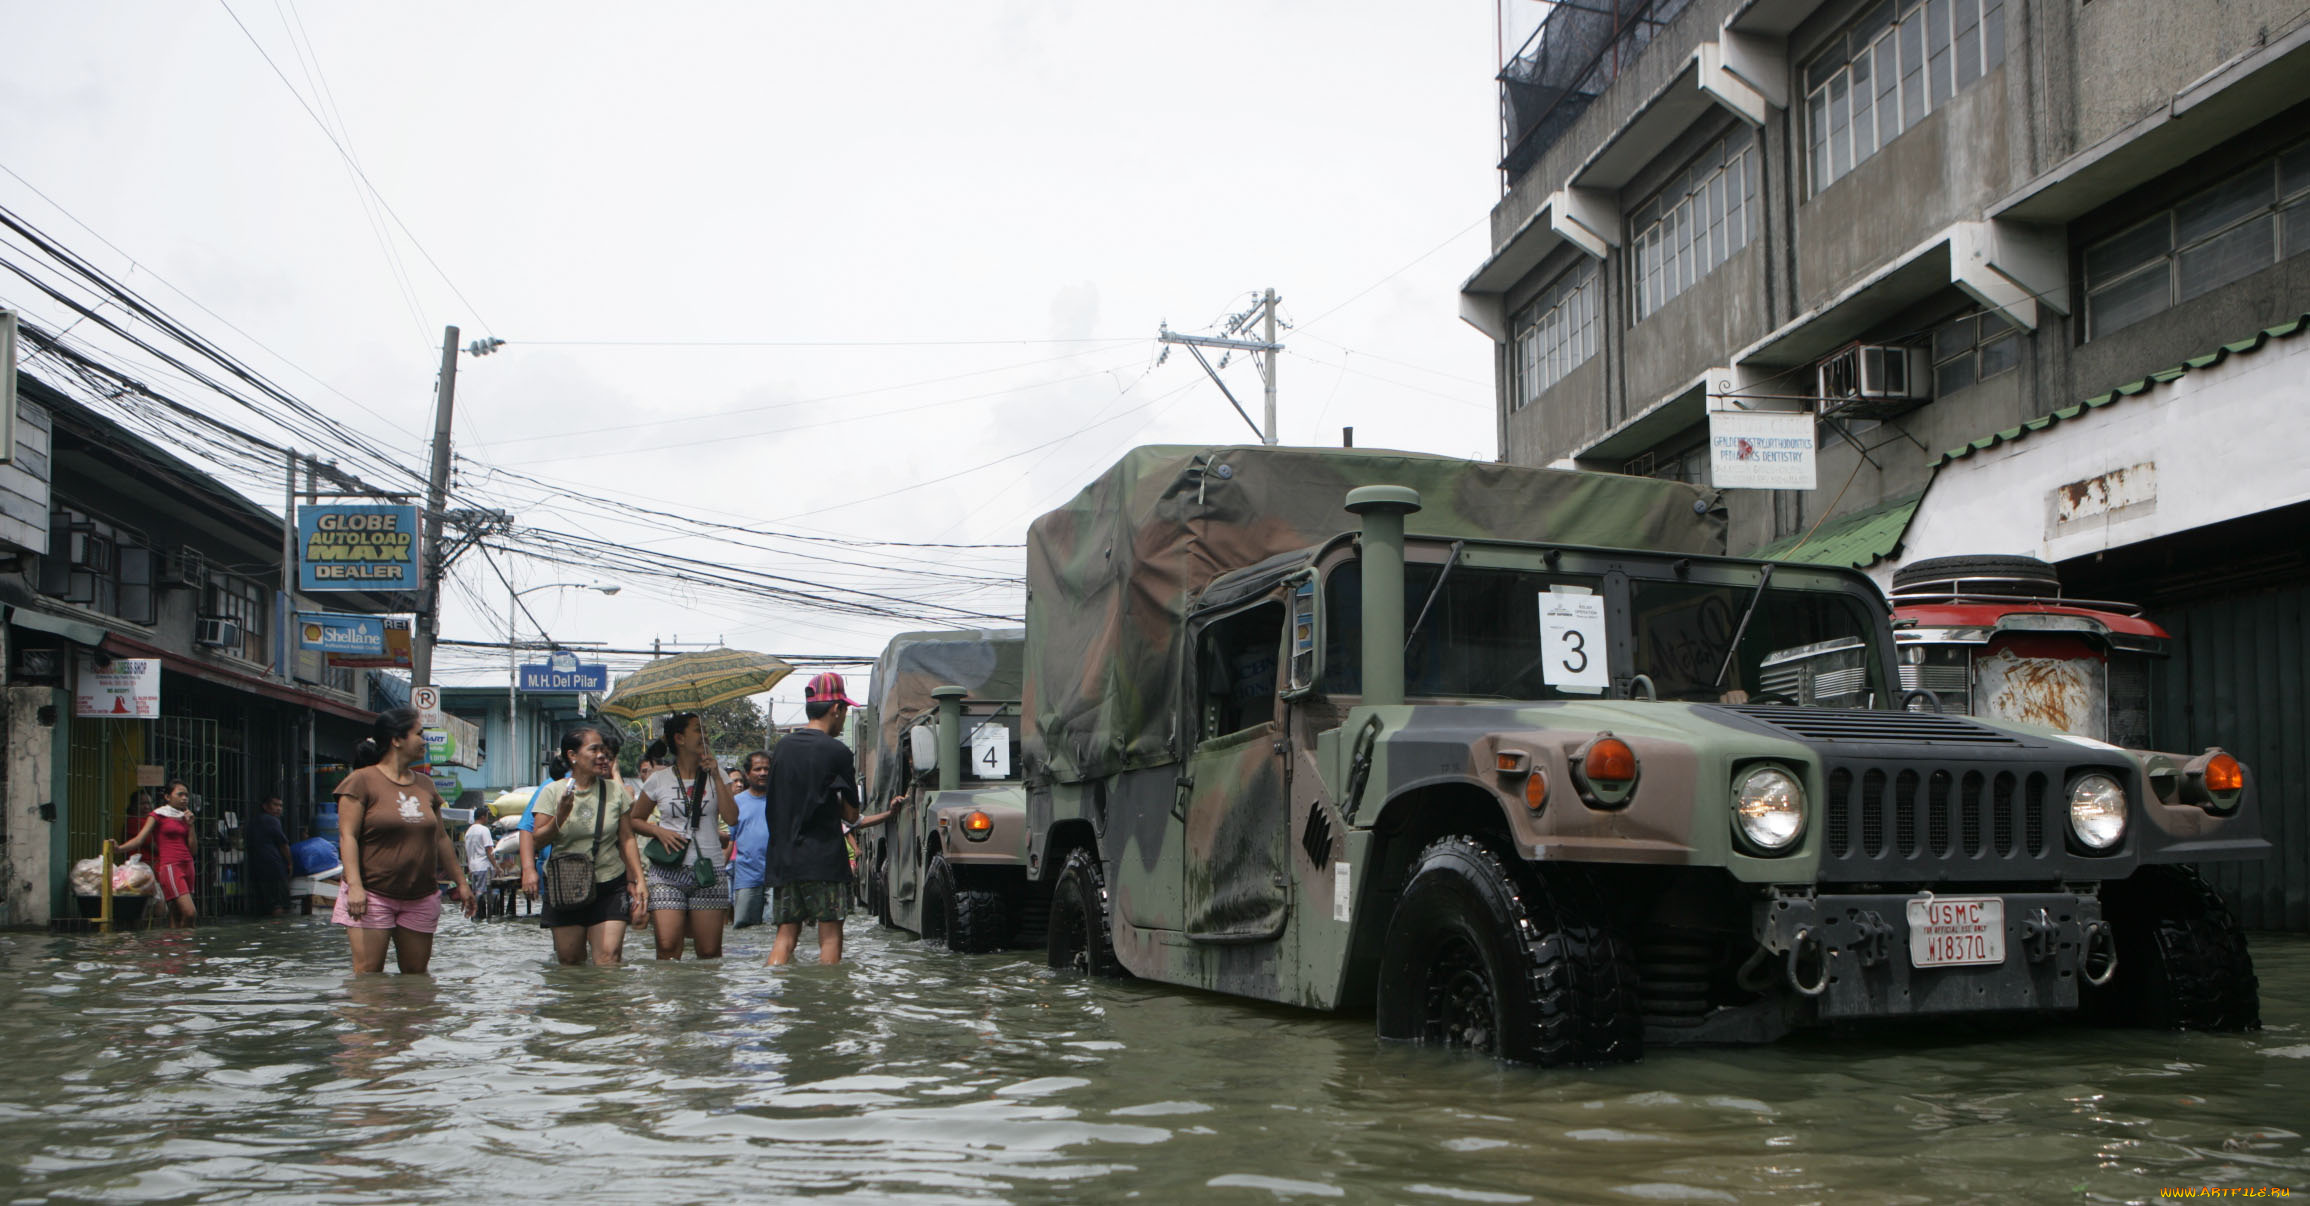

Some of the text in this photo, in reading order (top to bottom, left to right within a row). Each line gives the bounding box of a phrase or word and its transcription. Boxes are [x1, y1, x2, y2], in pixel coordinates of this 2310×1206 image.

[1762, 451, 1802, 463] DENTISTRY
[317, 514, 397, 532] GLOBE
[309, 532, 411, 545] AUTOLOAD
[306, 545, 411, 562] MAX
[315, 565, 404, 580] DEALER
[325, 627, 380, 645] Shellane
[1561, 629, 1588, 674] 3
[528, 674, 598, 688] M.H. Del Pilar
[421, 693, 430, 704] P
[982, 745, 998, 768] 4
[1929, 904, 1980, 924] USMC
